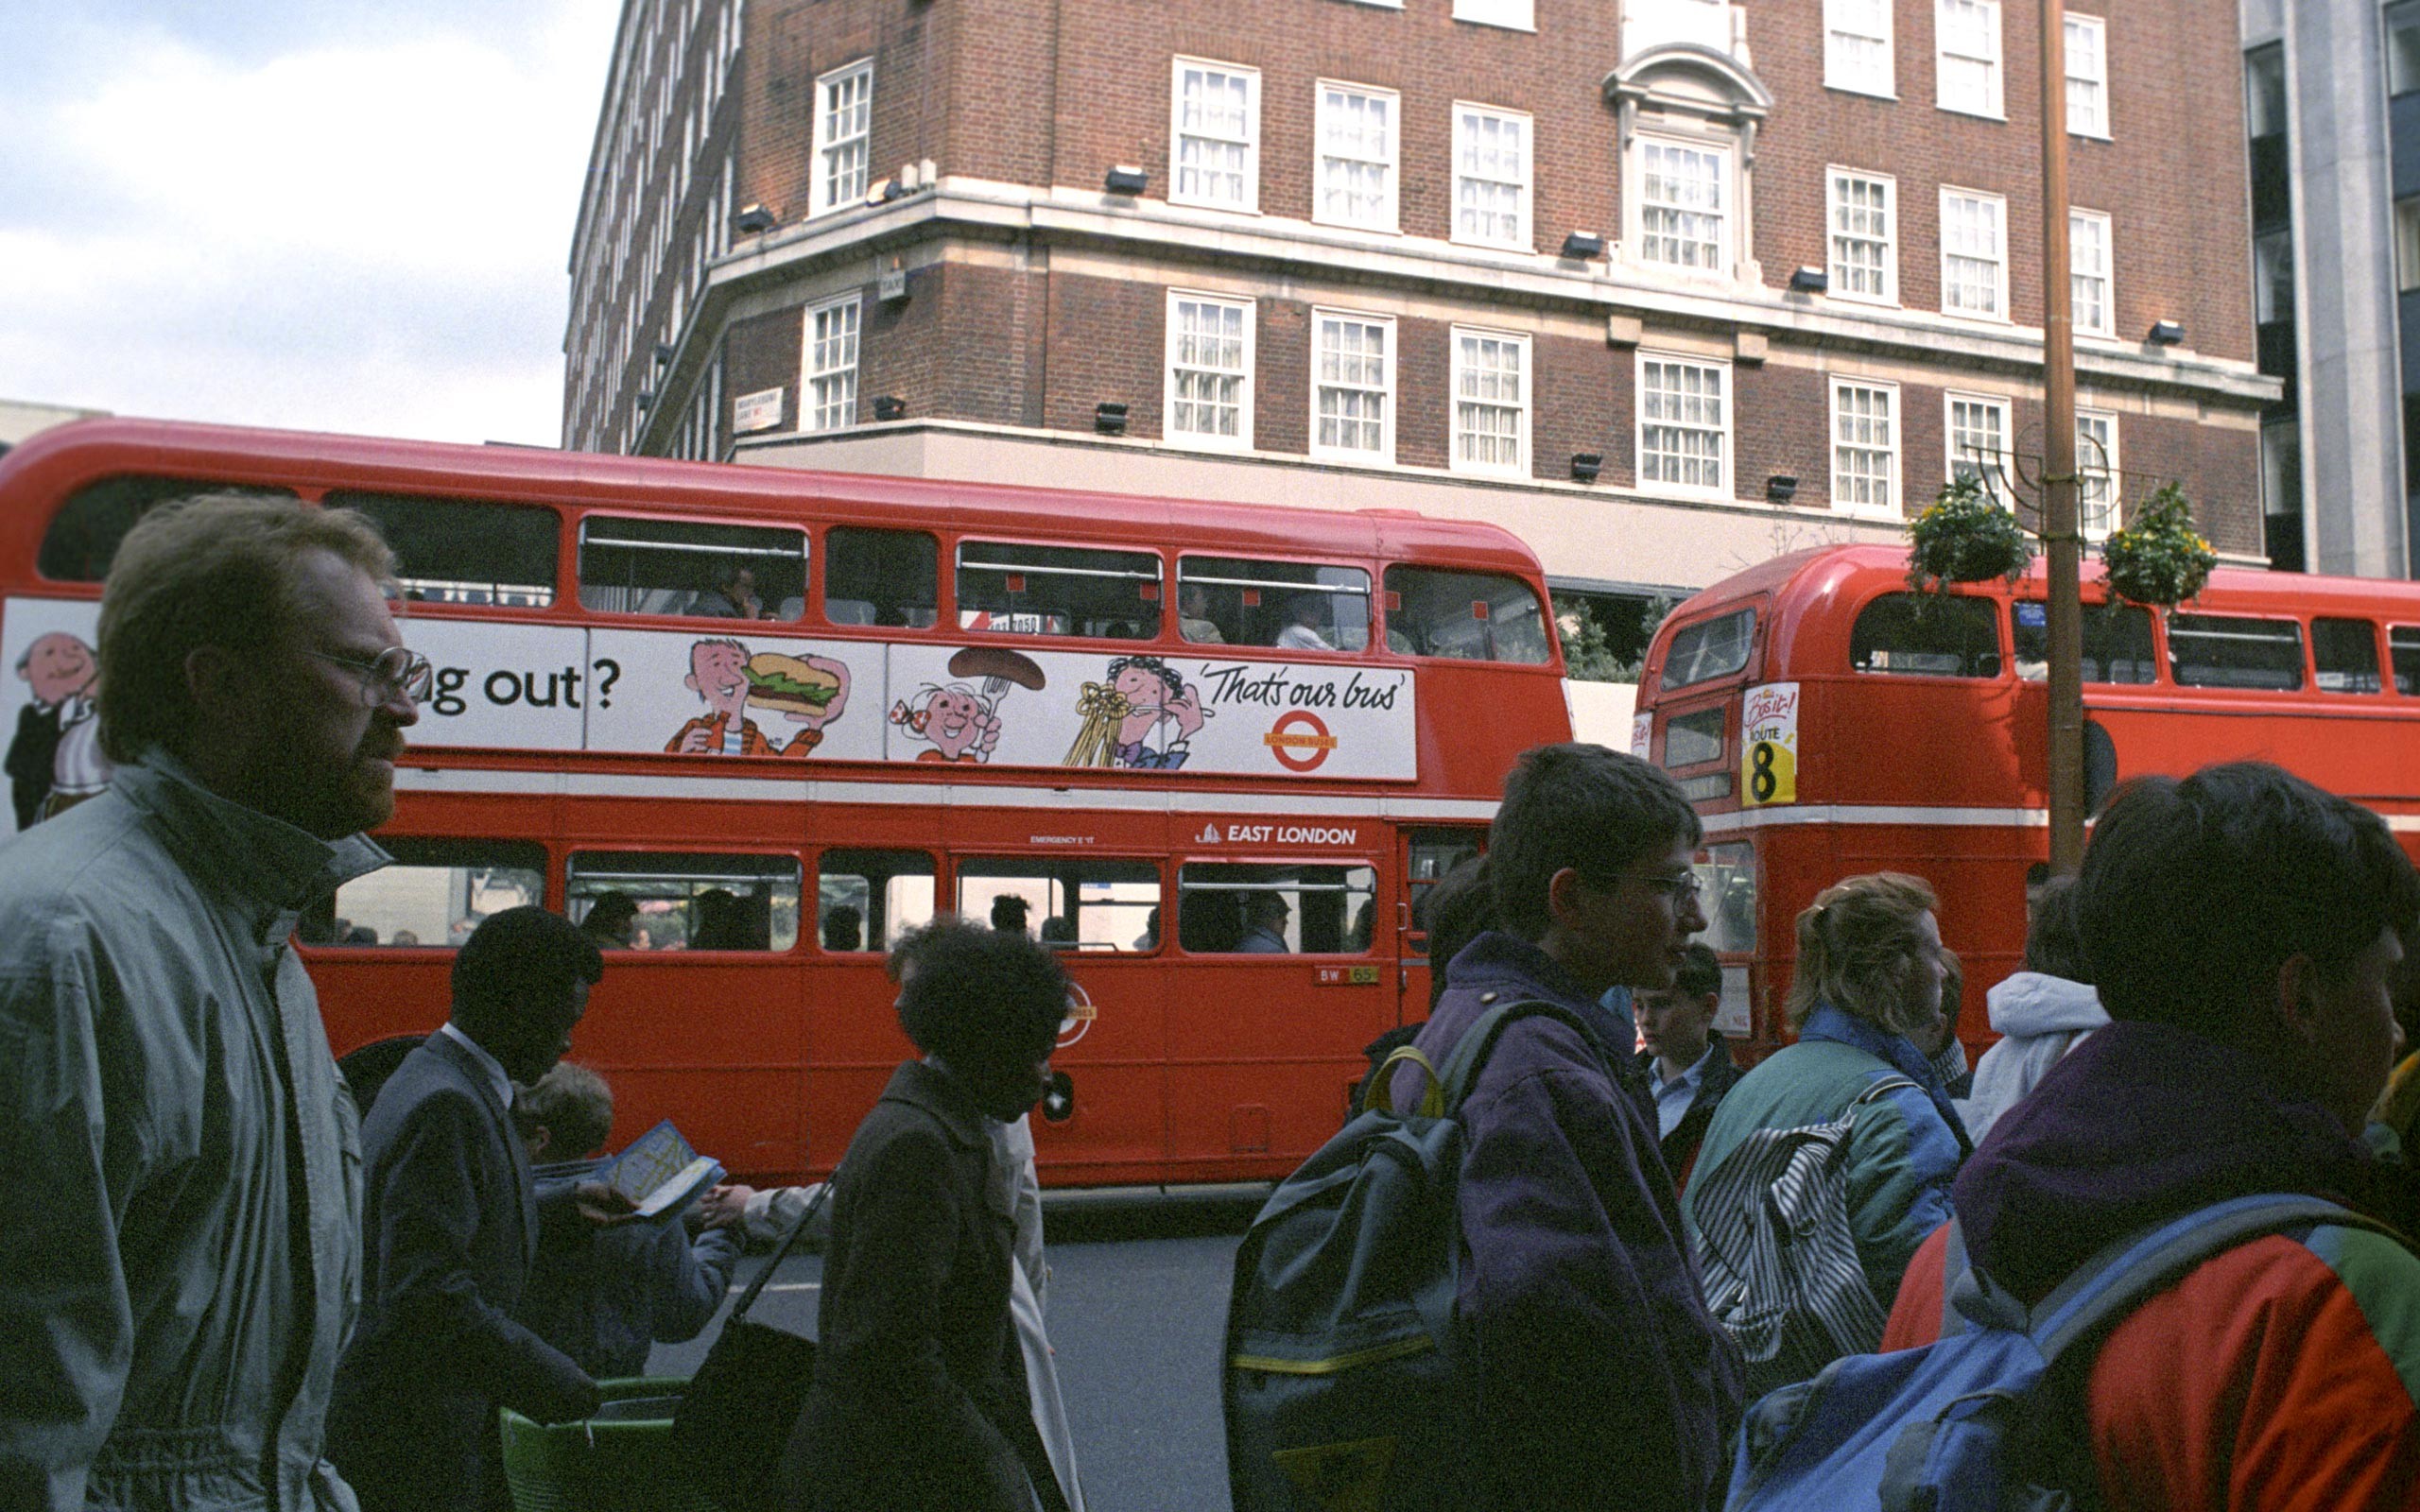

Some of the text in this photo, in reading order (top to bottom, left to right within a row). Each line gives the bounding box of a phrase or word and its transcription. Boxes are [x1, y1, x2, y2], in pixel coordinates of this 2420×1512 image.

[484, 658, 621, 710] out?
[1289, 683, 1336, 708] our
[1267, 734, 1305, 746] LONDON
[1751, 742, 1776, 802] 8
[1030, 835, 1077, 844] EMERGENCY
[1228, 825, 1357, 845] EAST LONDON
[1321, 968, 1372, 982] BW 65
